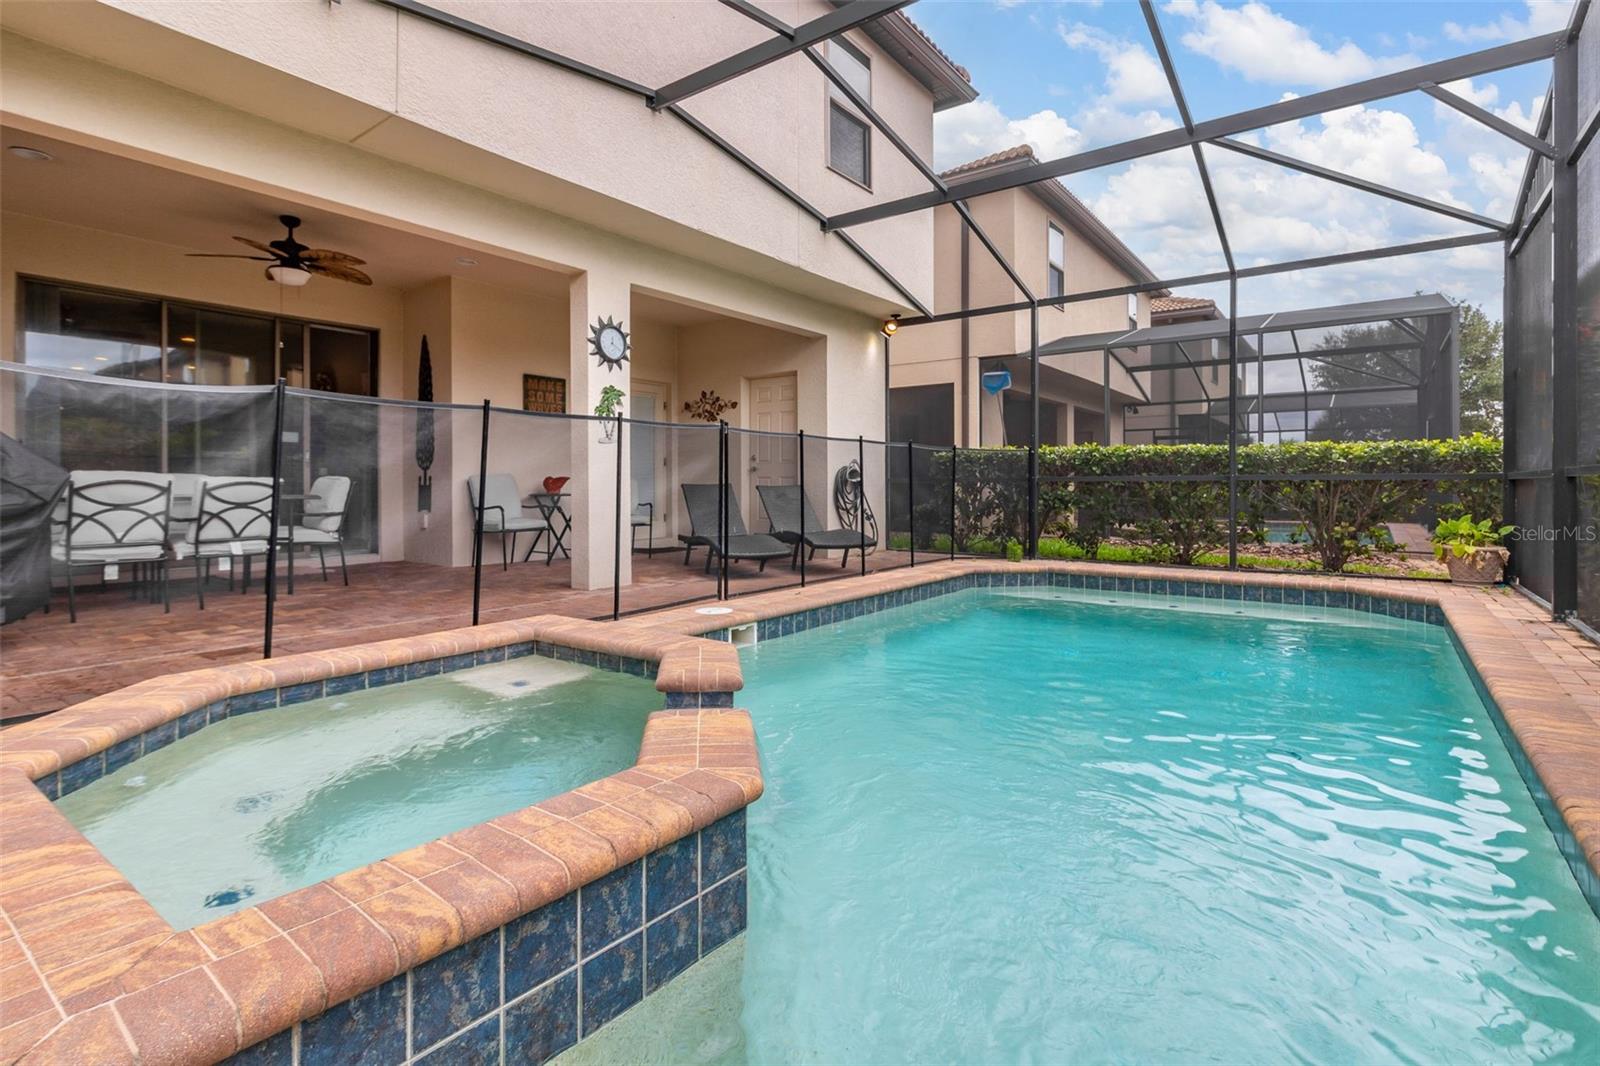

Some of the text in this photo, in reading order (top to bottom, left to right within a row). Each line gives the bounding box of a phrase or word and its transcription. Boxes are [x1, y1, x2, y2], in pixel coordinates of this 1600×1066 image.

[528, 379, 563, 392] MAKE
[528, 390, 563, 403] SOME
[528, 402, 563, 413] WAVES
